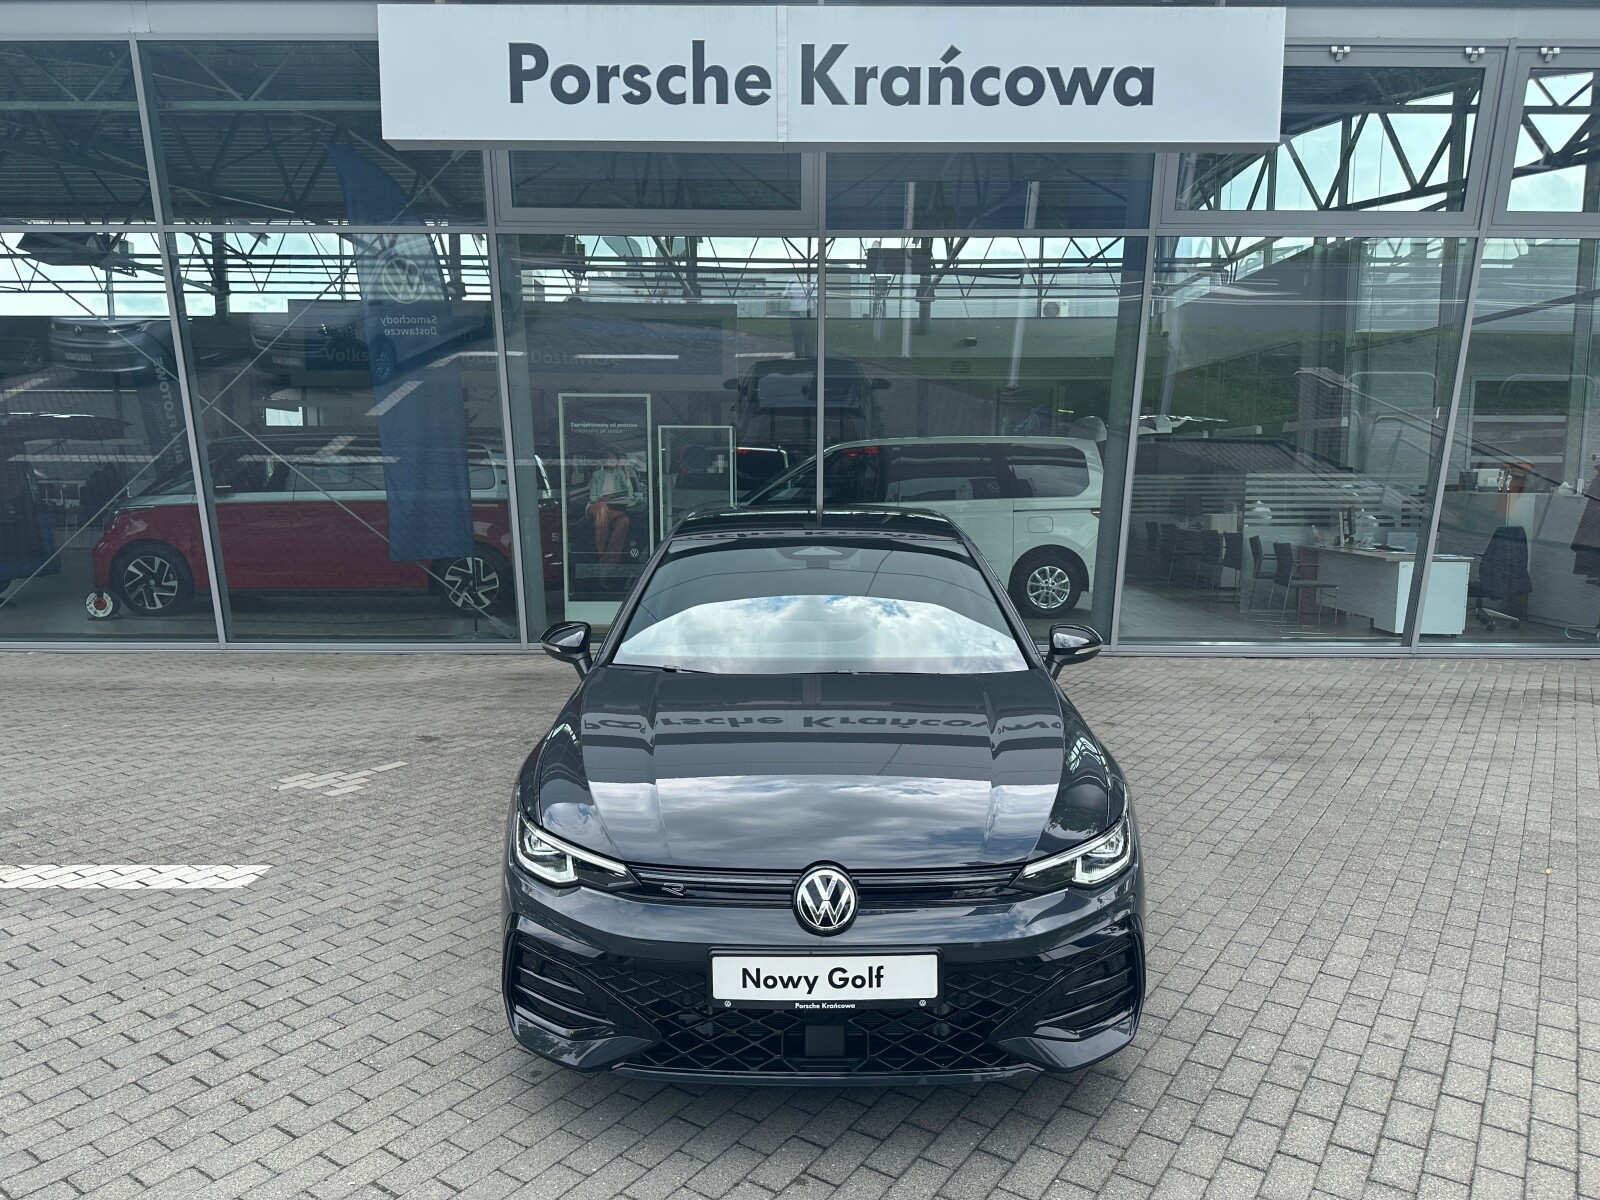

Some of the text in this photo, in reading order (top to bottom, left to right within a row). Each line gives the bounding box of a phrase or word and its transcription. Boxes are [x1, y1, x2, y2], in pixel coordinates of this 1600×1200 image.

[508, 40, 1155, 107] Porsche Krańcowa
[741, 965, 884, 994] Nowy Golf
